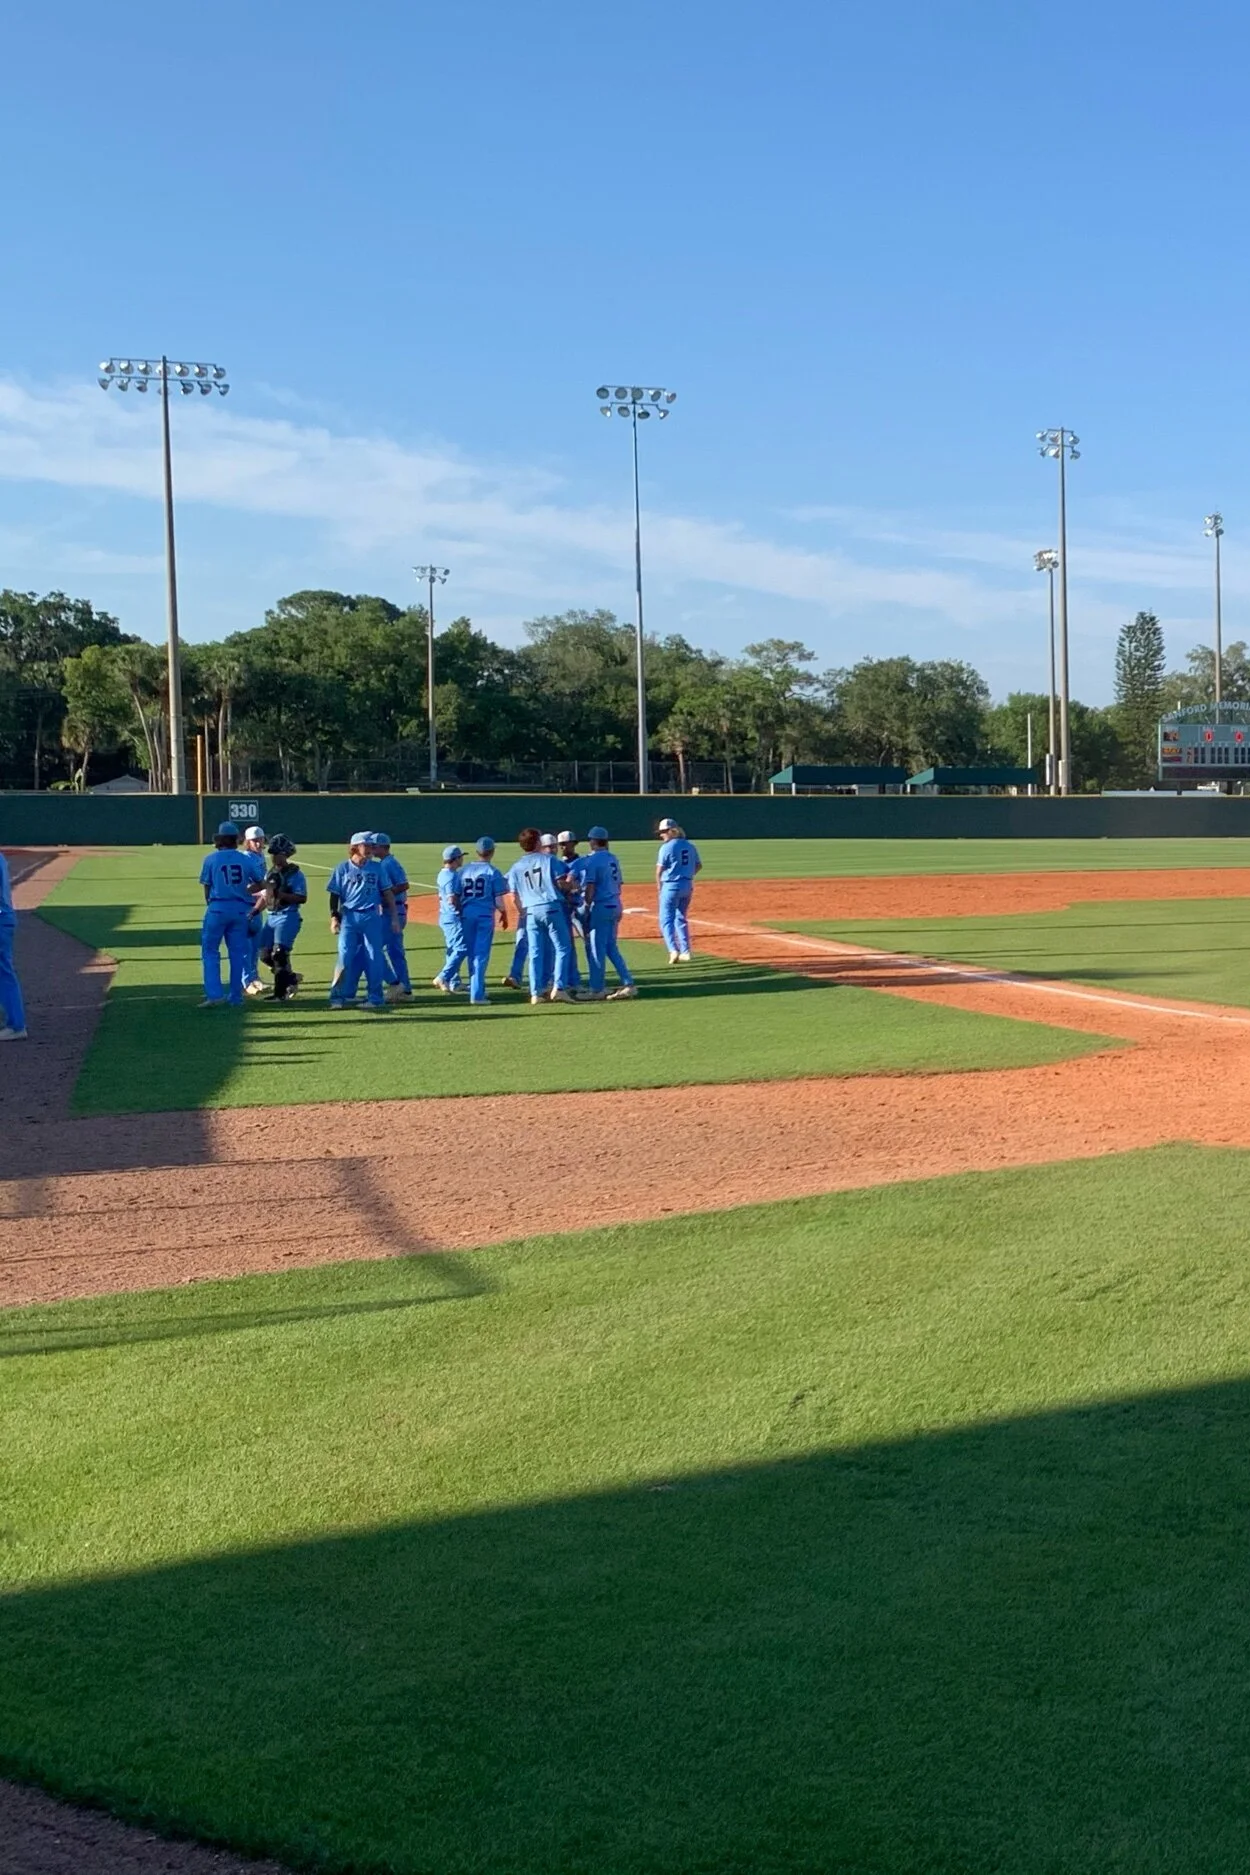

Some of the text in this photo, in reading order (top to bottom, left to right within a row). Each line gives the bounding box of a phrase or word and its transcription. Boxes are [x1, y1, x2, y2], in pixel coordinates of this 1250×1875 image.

[1162, 703, 1207, 723] SANFORD
[230, 804, 257, 818] 330
[681, 849, 689, 866] 6
[220, 864, 243, 885] 13
[524, 867, 543, 890] 17
[463, 877, 486, 898] 29
